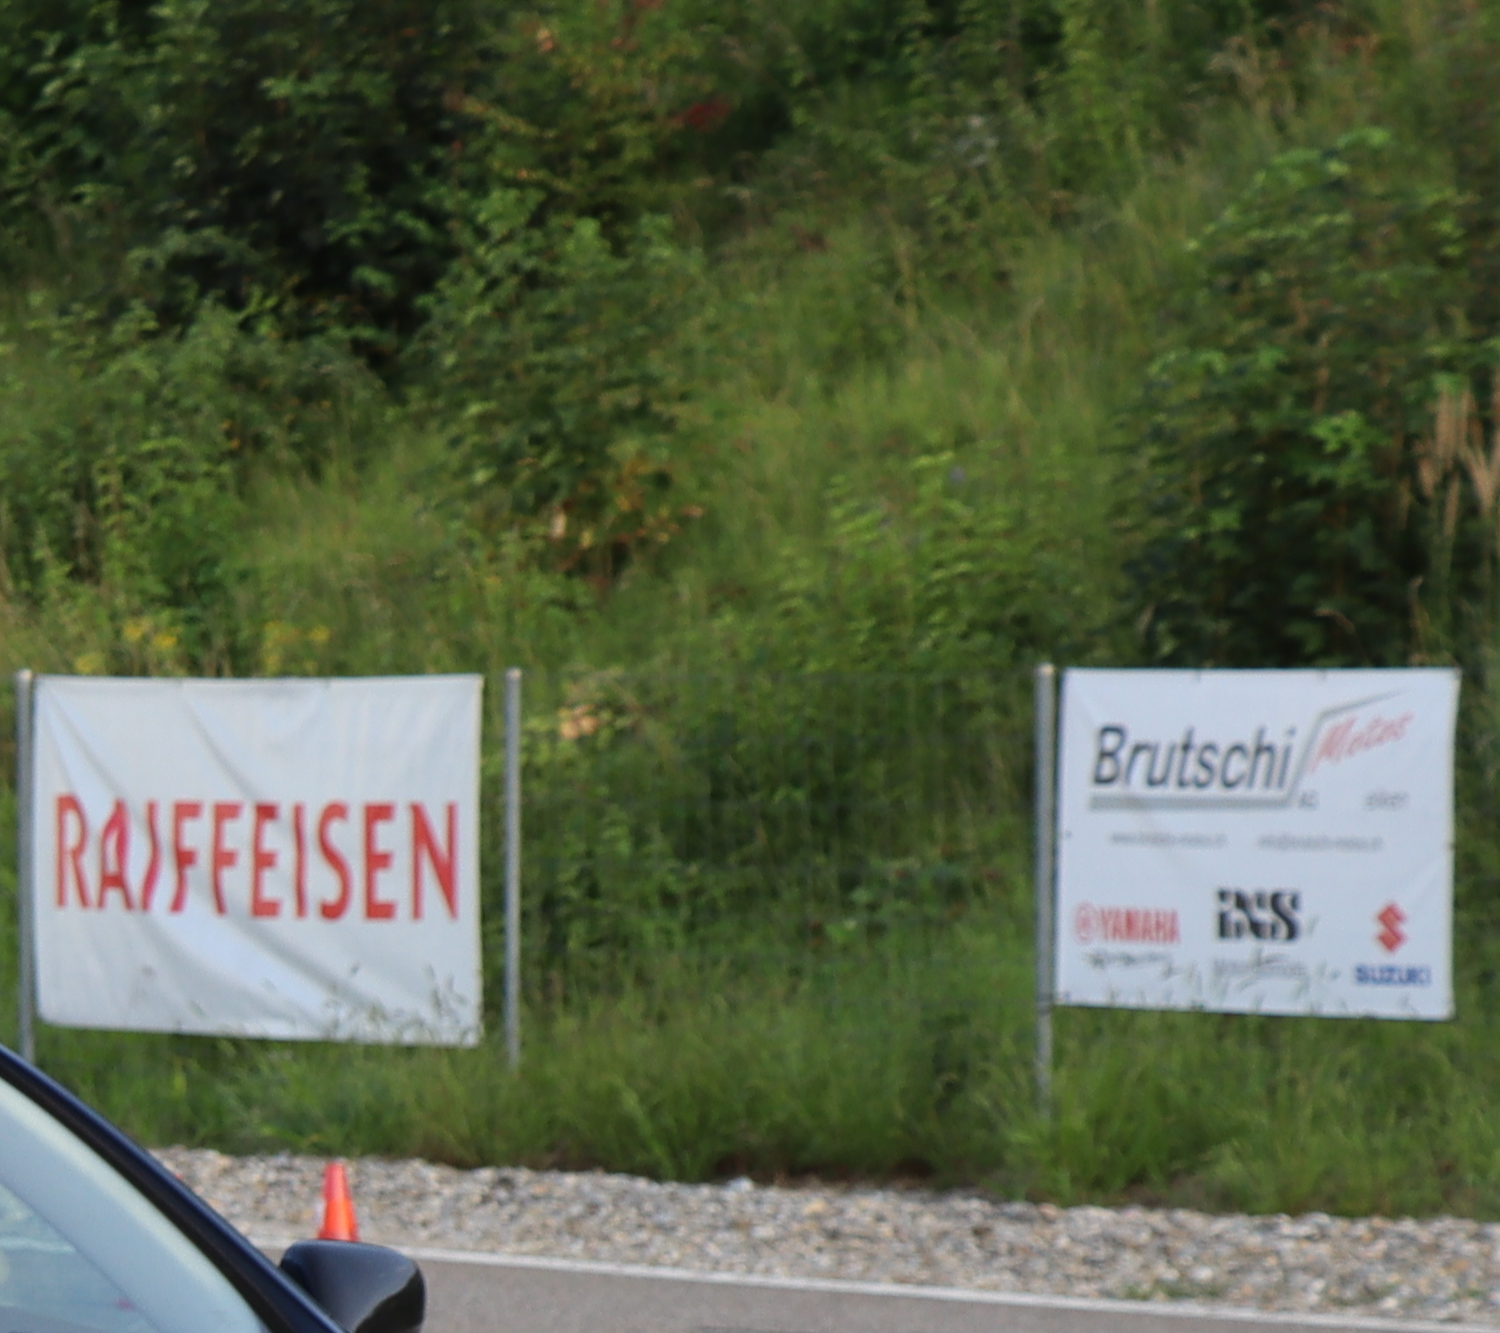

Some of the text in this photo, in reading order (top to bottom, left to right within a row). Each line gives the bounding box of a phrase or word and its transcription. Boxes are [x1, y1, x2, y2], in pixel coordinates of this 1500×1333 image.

[1092, 724, 1296, 790] Brutschi
[56, 793, 459, 921] RAIFFEISEN
[1099, 908, 1181, 944] YAMAHA
[1353, 965, 1433, 987] SUZUKI
